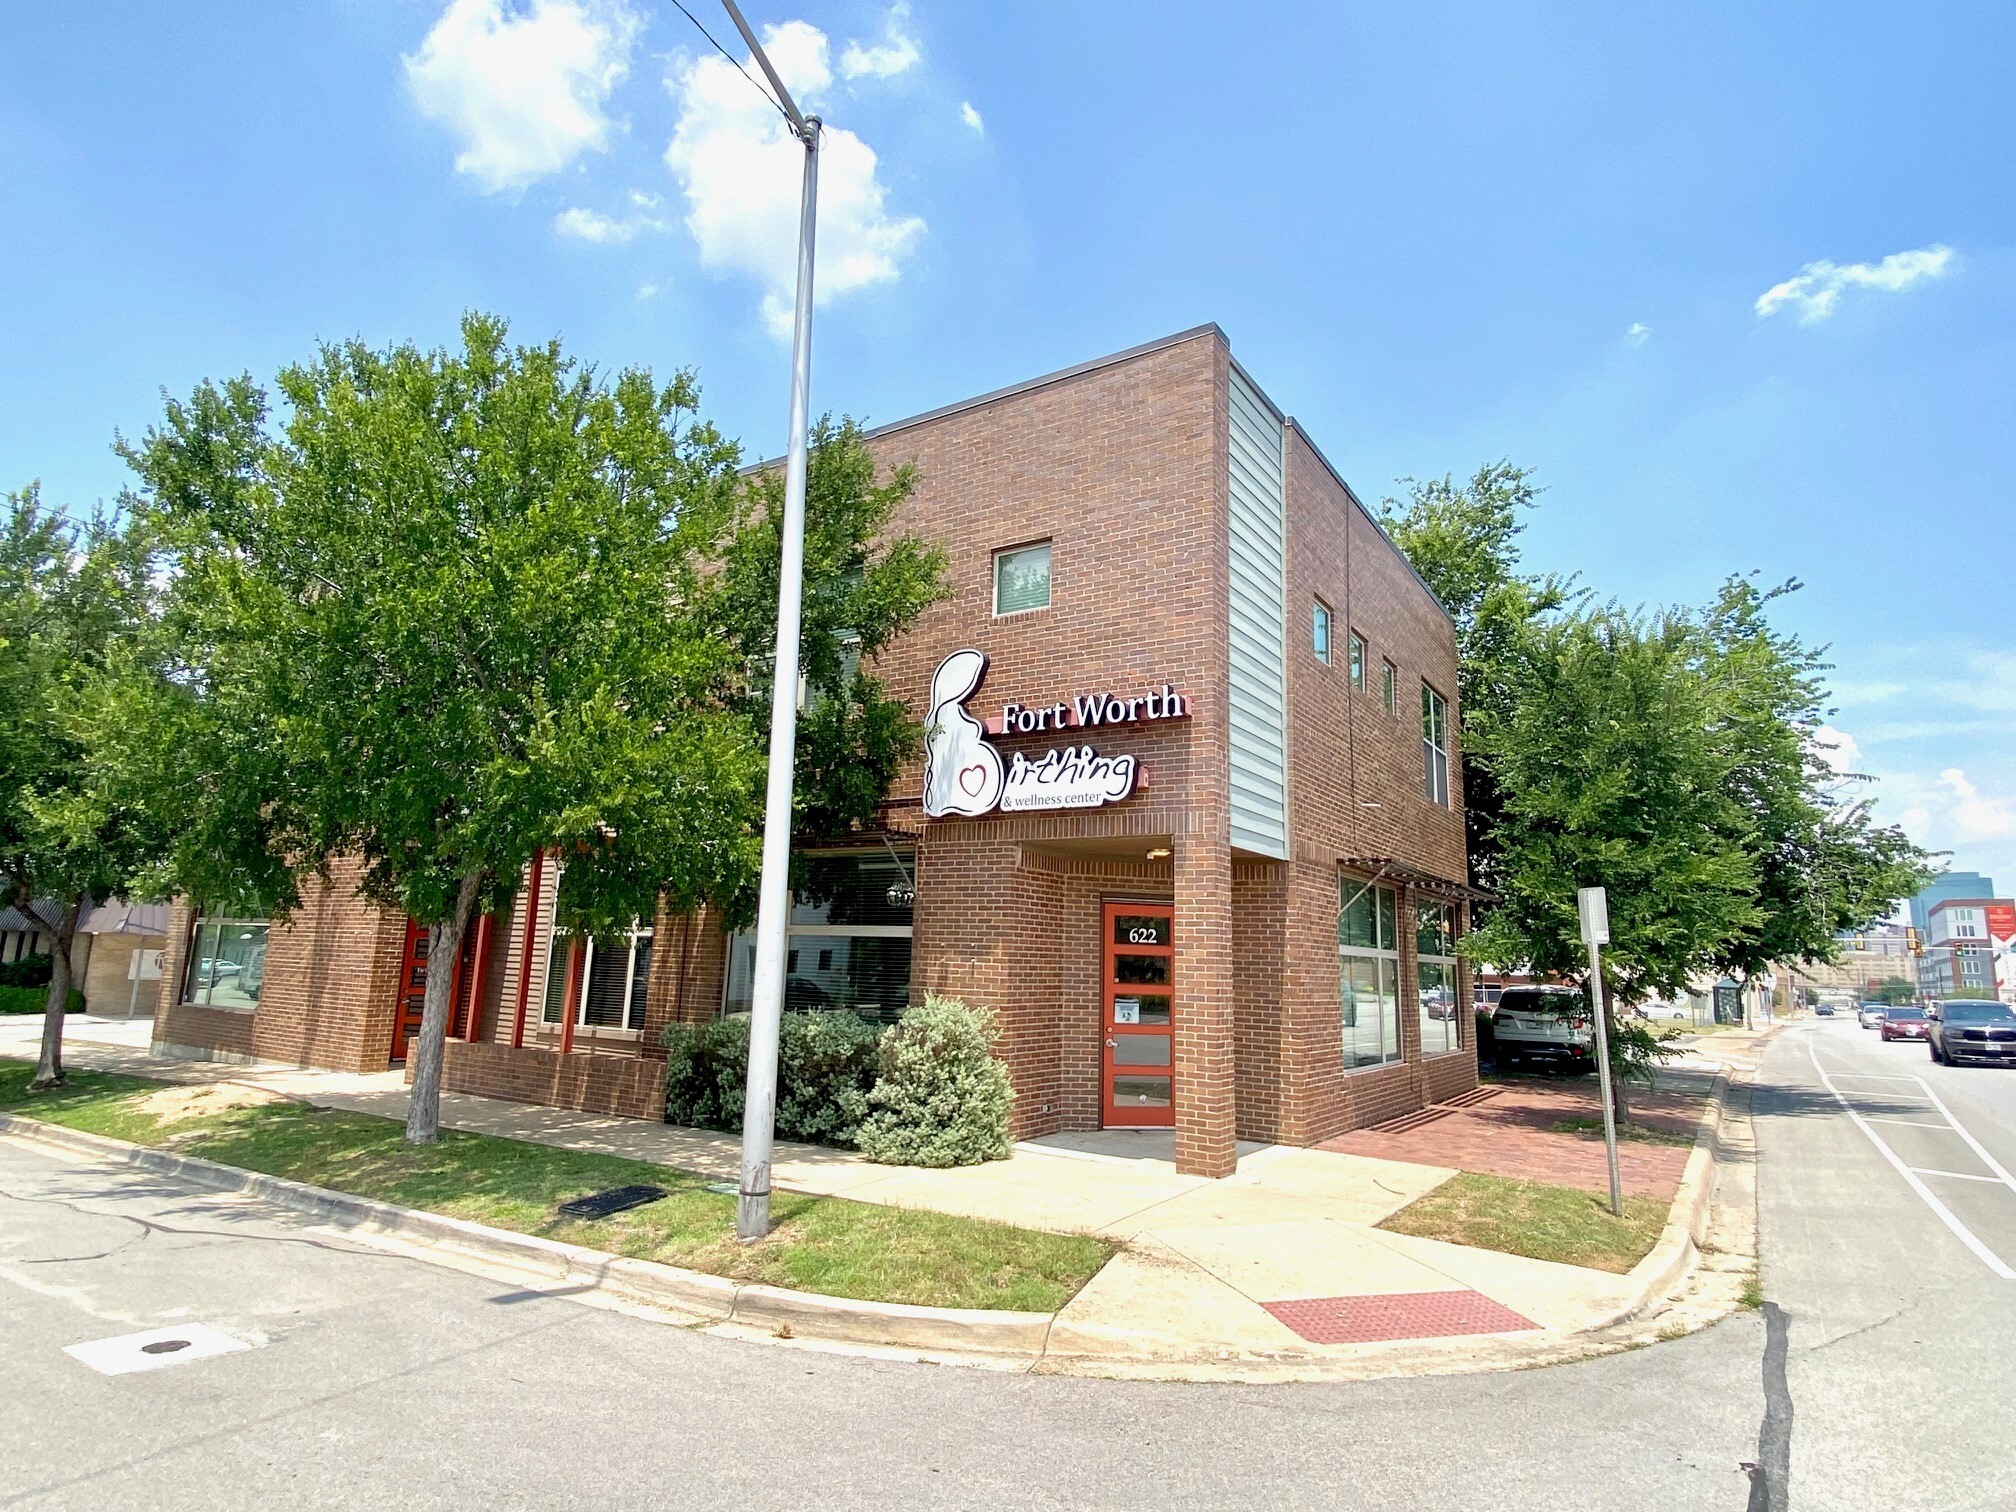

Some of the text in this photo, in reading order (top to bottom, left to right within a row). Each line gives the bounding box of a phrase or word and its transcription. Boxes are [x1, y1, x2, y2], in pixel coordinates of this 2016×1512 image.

[1000, 685, 1183, 735] Fort Worth
[1003, 792, 1102, 808] & wellness center
[1129, 927, 1158, 944] 622
